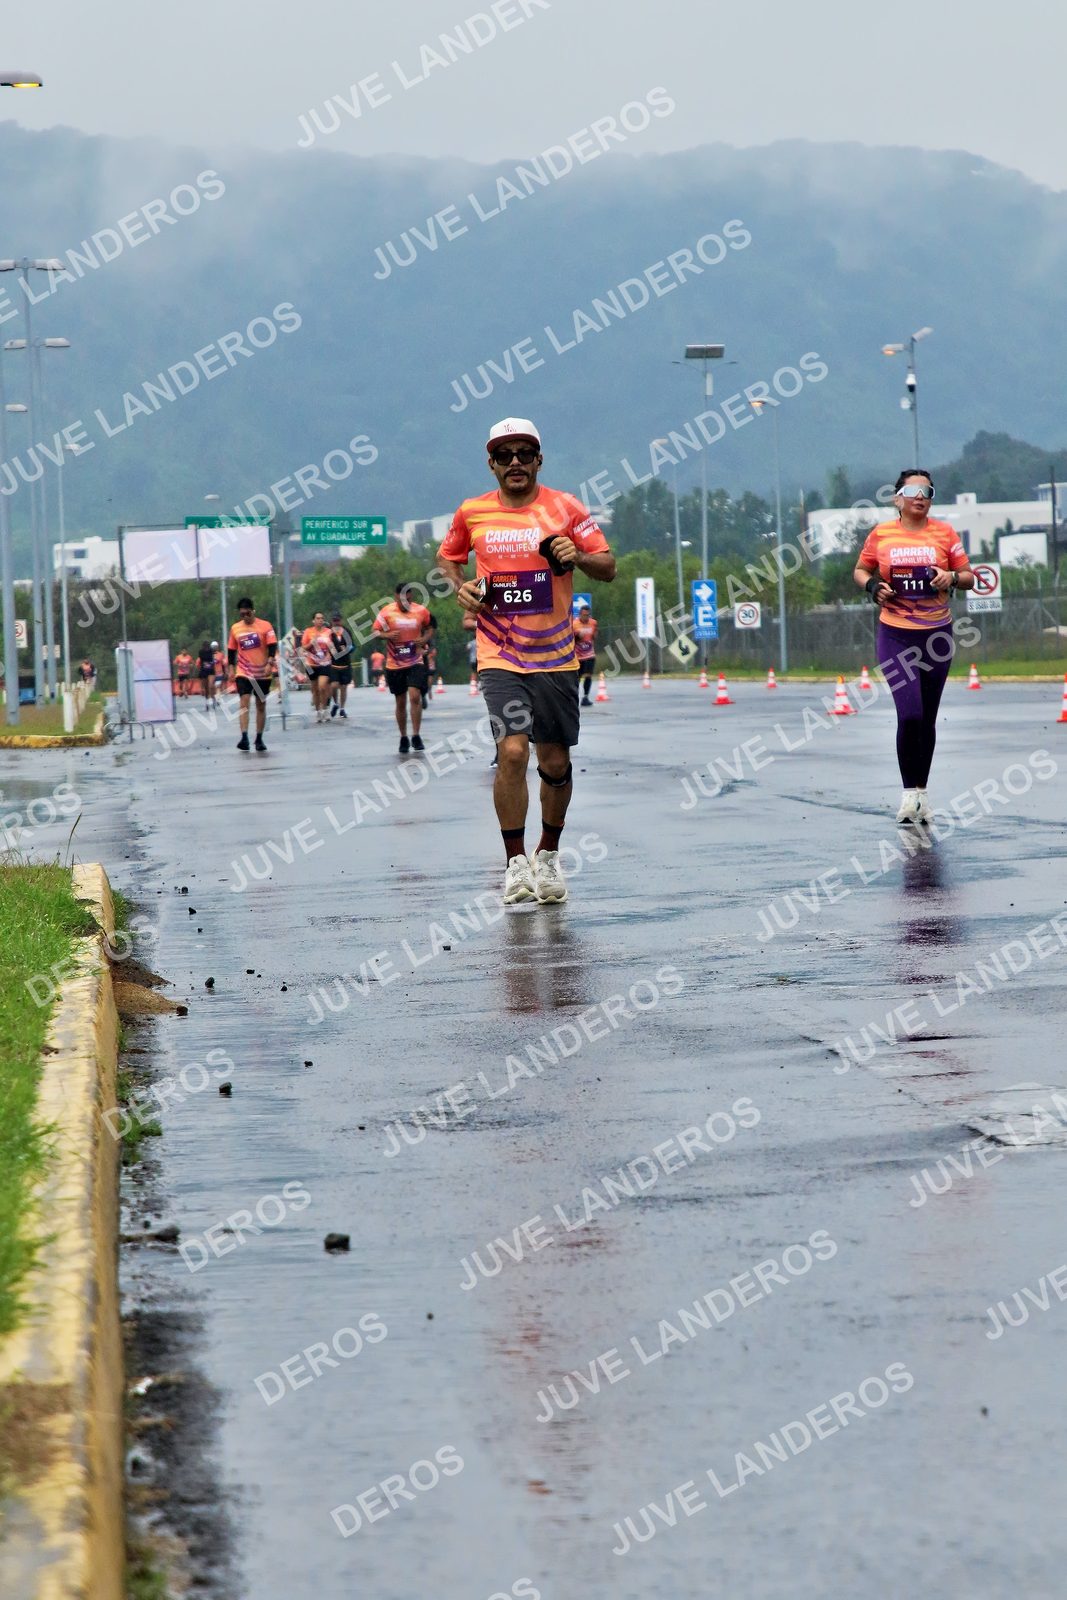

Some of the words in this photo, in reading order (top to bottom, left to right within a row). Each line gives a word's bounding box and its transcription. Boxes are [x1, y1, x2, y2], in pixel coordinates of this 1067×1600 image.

[352, 520, 368, 528] SUR
[485, 527, 541, 543] CARRERA
[486, 542, 528, 554] OMNILIFE
[890, 546, 936, 558] CARRERA
[892, 557, 928, 565] OMNILIFE
[902, 580, 924, 590] 111
[503, 590, 532, 603] 626
[698, 606, 713, 626] E
[741, 609, 754, 618] 30
